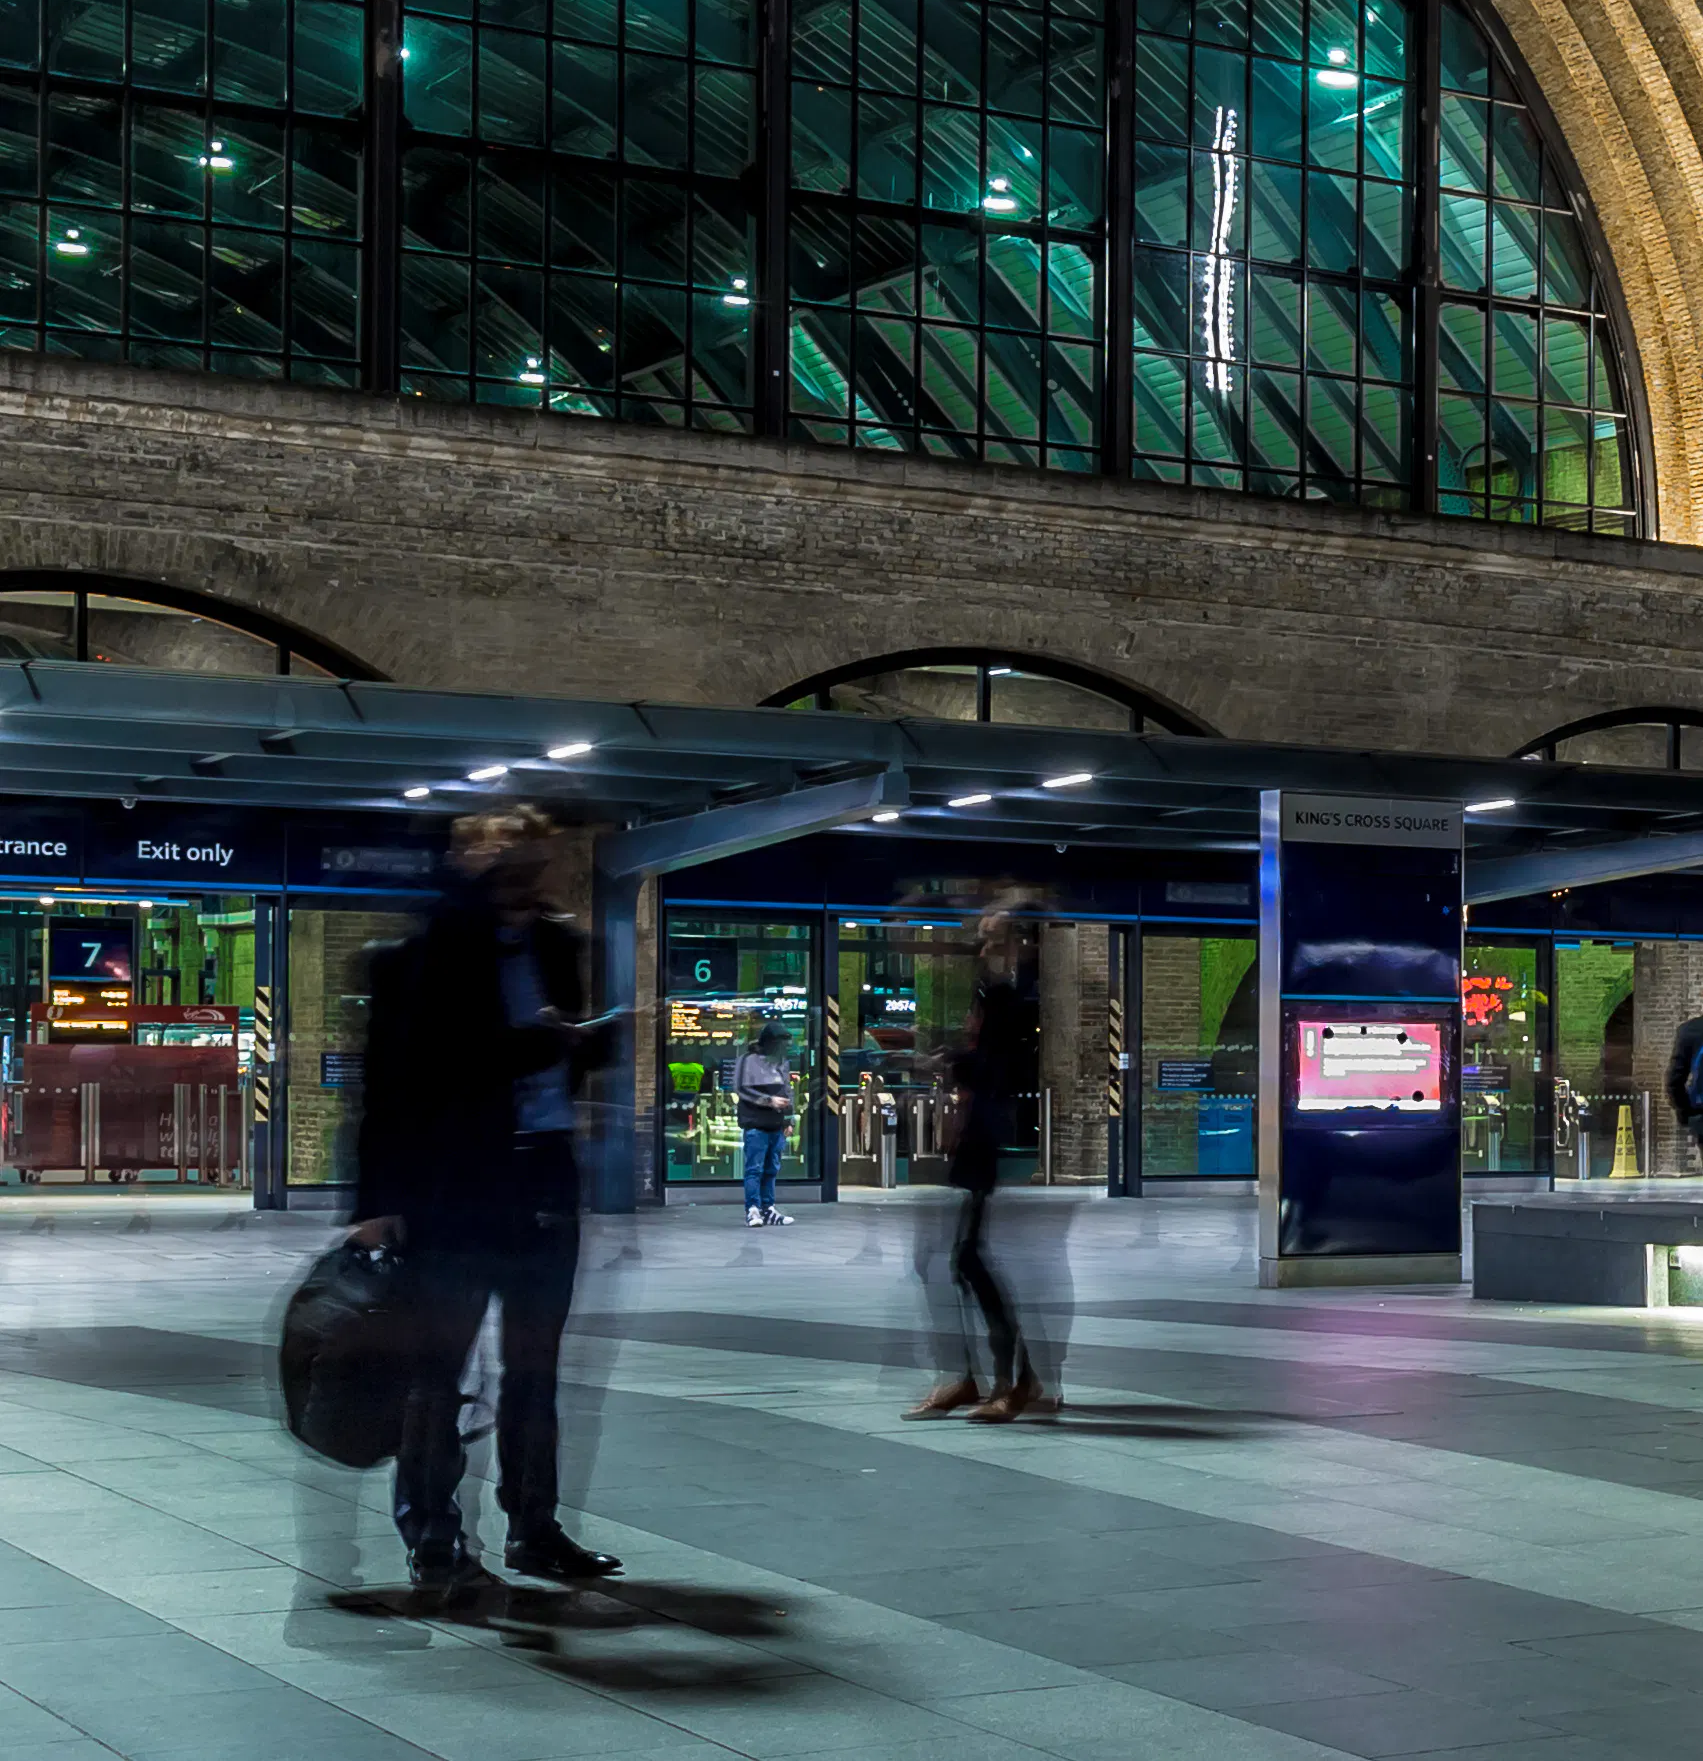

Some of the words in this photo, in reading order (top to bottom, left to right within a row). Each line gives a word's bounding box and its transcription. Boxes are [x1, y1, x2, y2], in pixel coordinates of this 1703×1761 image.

[1295, 811, 1342, 827] KING'S
[1345, 813, 1391, 829] CROSS
[1394, 816, 1449, 832] SQUARE
[138, 840, 180, 861] Exit
[186, 843, 234, 866] only
[81, 942, 102, 968] 7
[694, 959, 712, 983] 6
